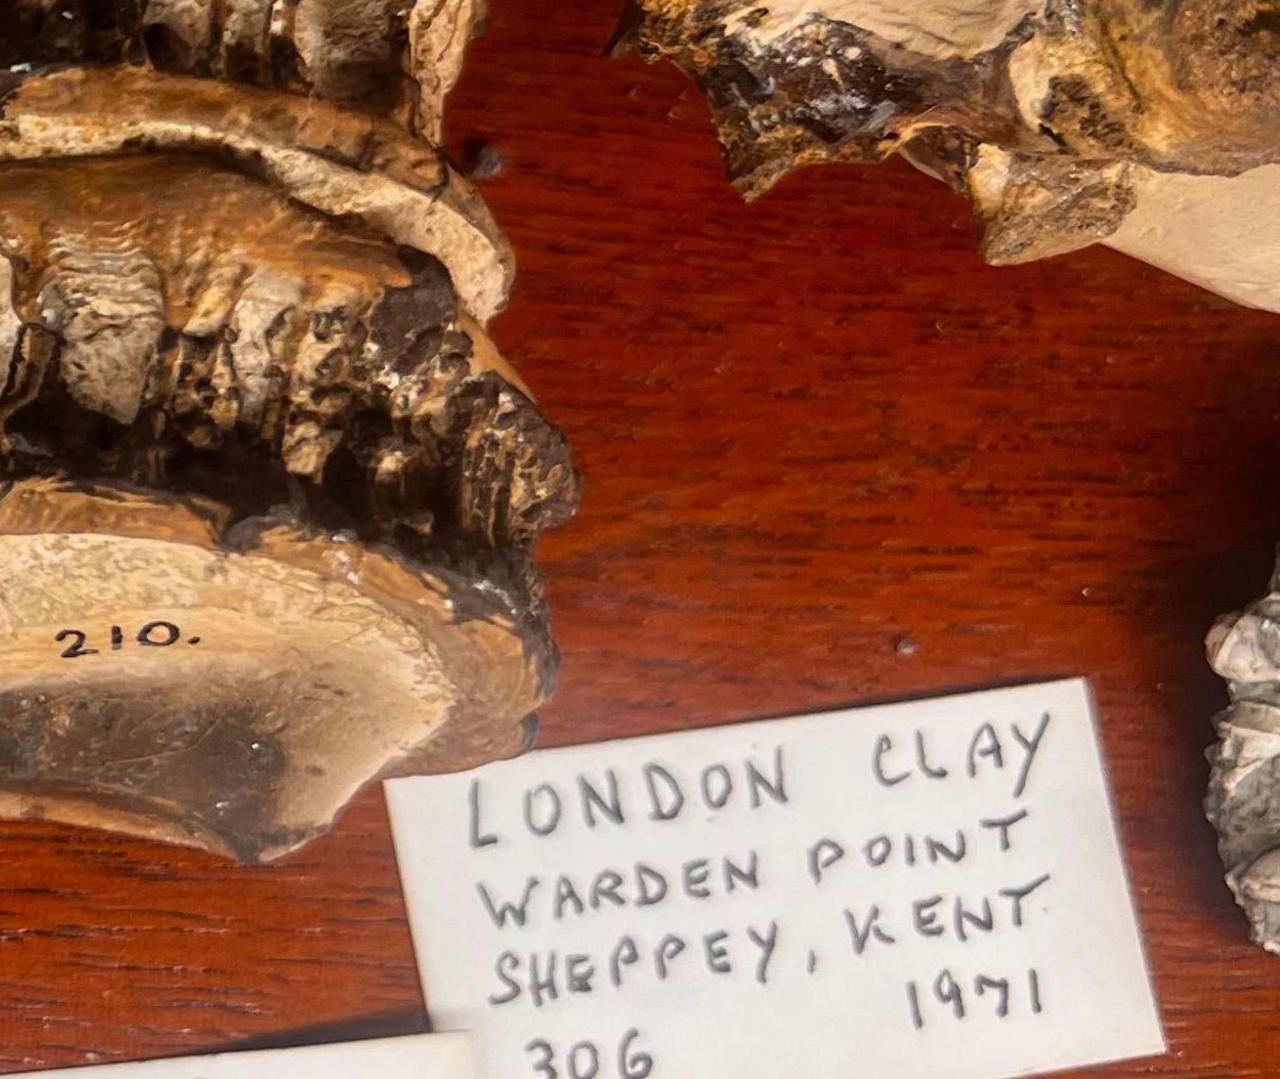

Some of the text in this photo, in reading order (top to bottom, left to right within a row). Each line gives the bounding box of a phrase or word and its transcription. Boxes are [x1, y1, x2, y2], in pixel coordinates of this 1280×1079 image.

[54, 620, 201, 658] 210.
[469, 713, 1051, 850] LONDON CLAY
[476, 808, 1030, 930] WARDEN POINT
[525, 966, 1044, 1079] 306 1971
